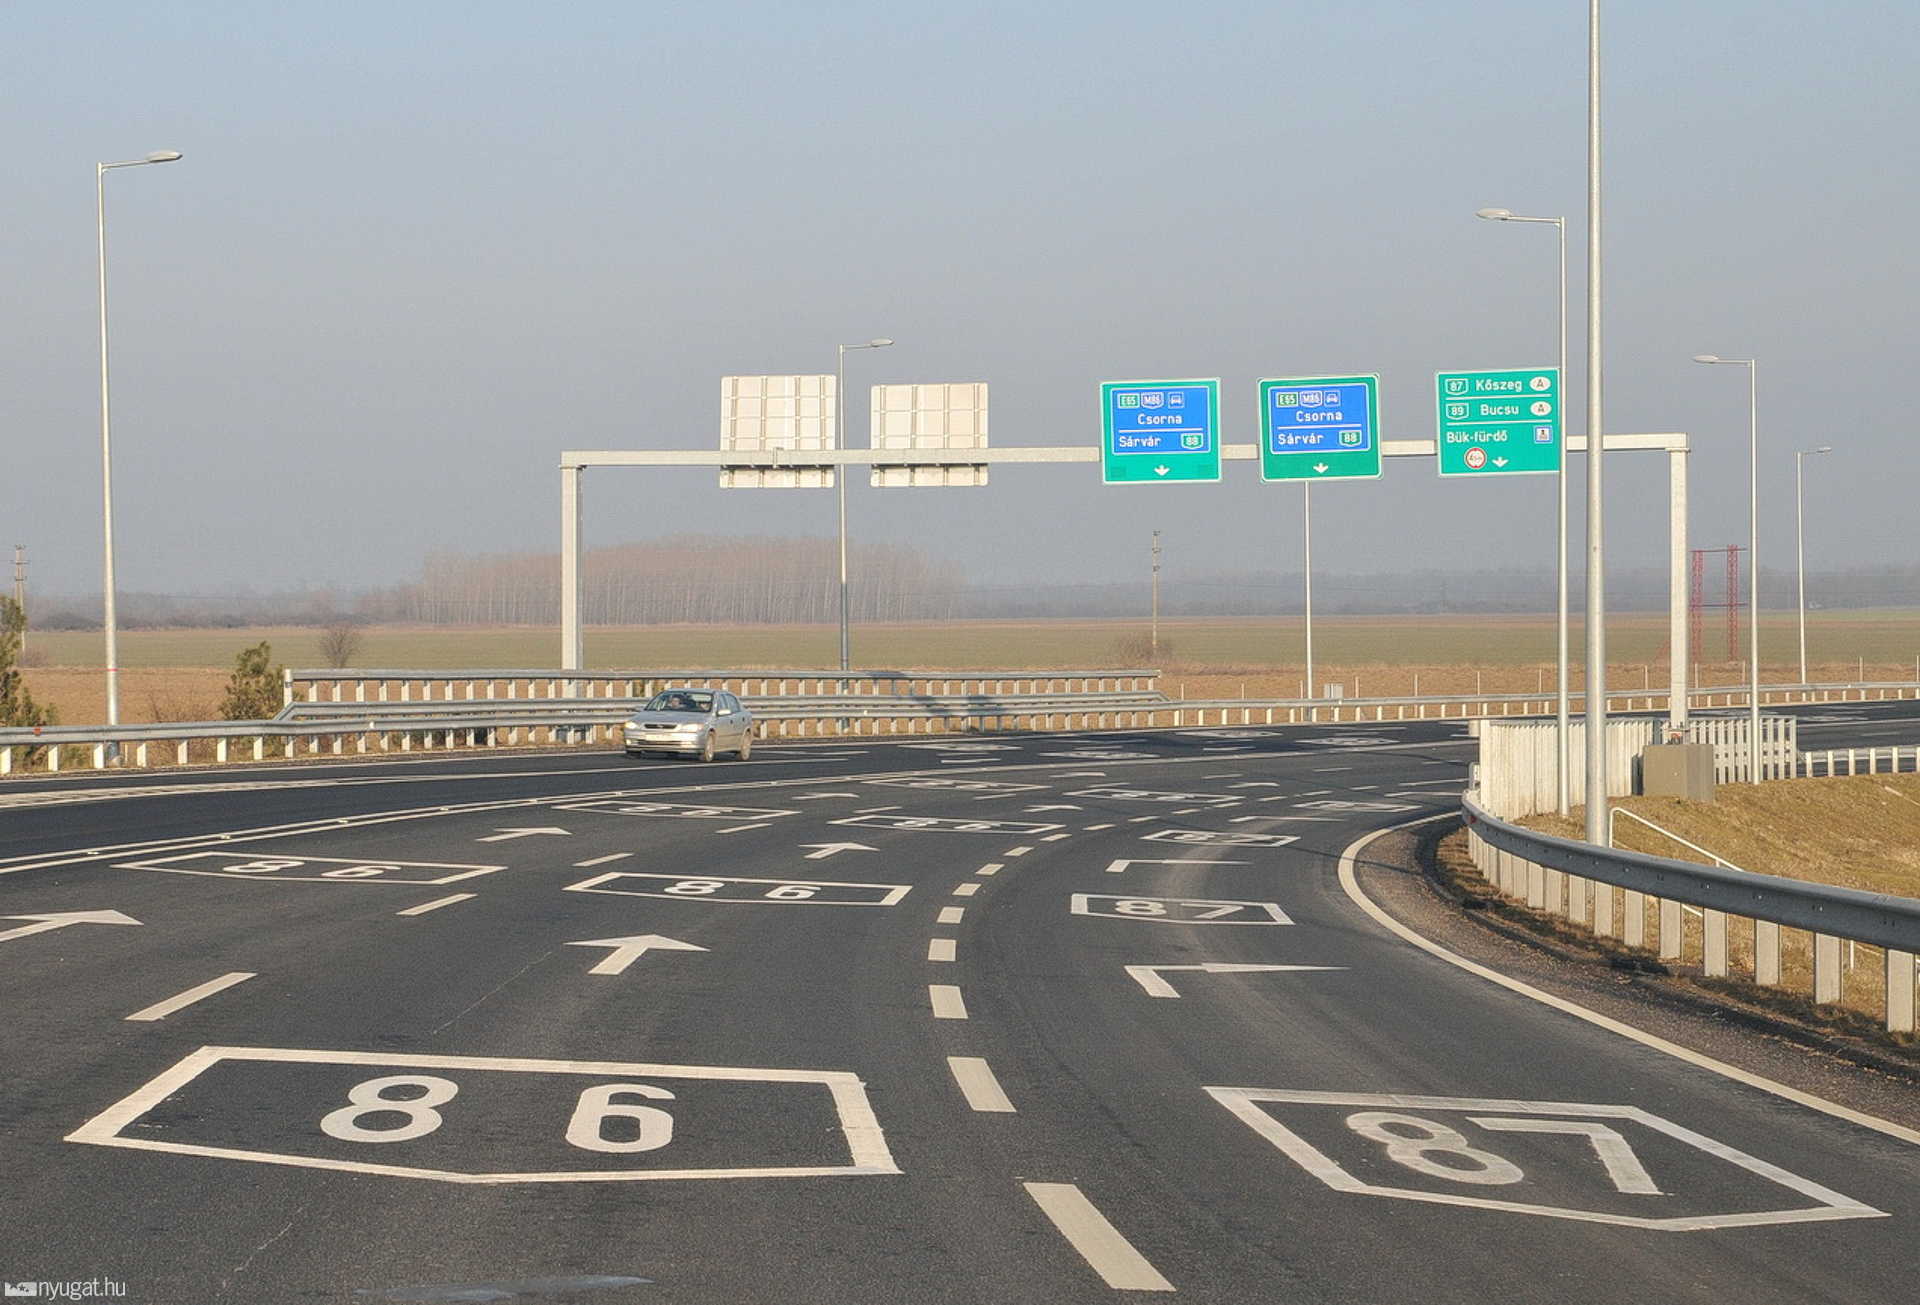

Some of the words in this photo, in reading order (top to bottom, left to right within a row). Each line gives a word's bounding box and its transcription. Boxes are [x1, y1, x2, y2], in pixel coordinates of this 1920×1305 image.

[1449, 382, 1463, 392] 87
[1296, 410, 1343, 422] Csorna
[1480, 404, 1519, 416] Bucsu
[1137, 413, 1182, 425] Csorna
[1119, 436, 1161, 448] Sárvár
[1278, 433, 1324, 445] Sárvár
[1345, 1111, 1662, 1195] 87
